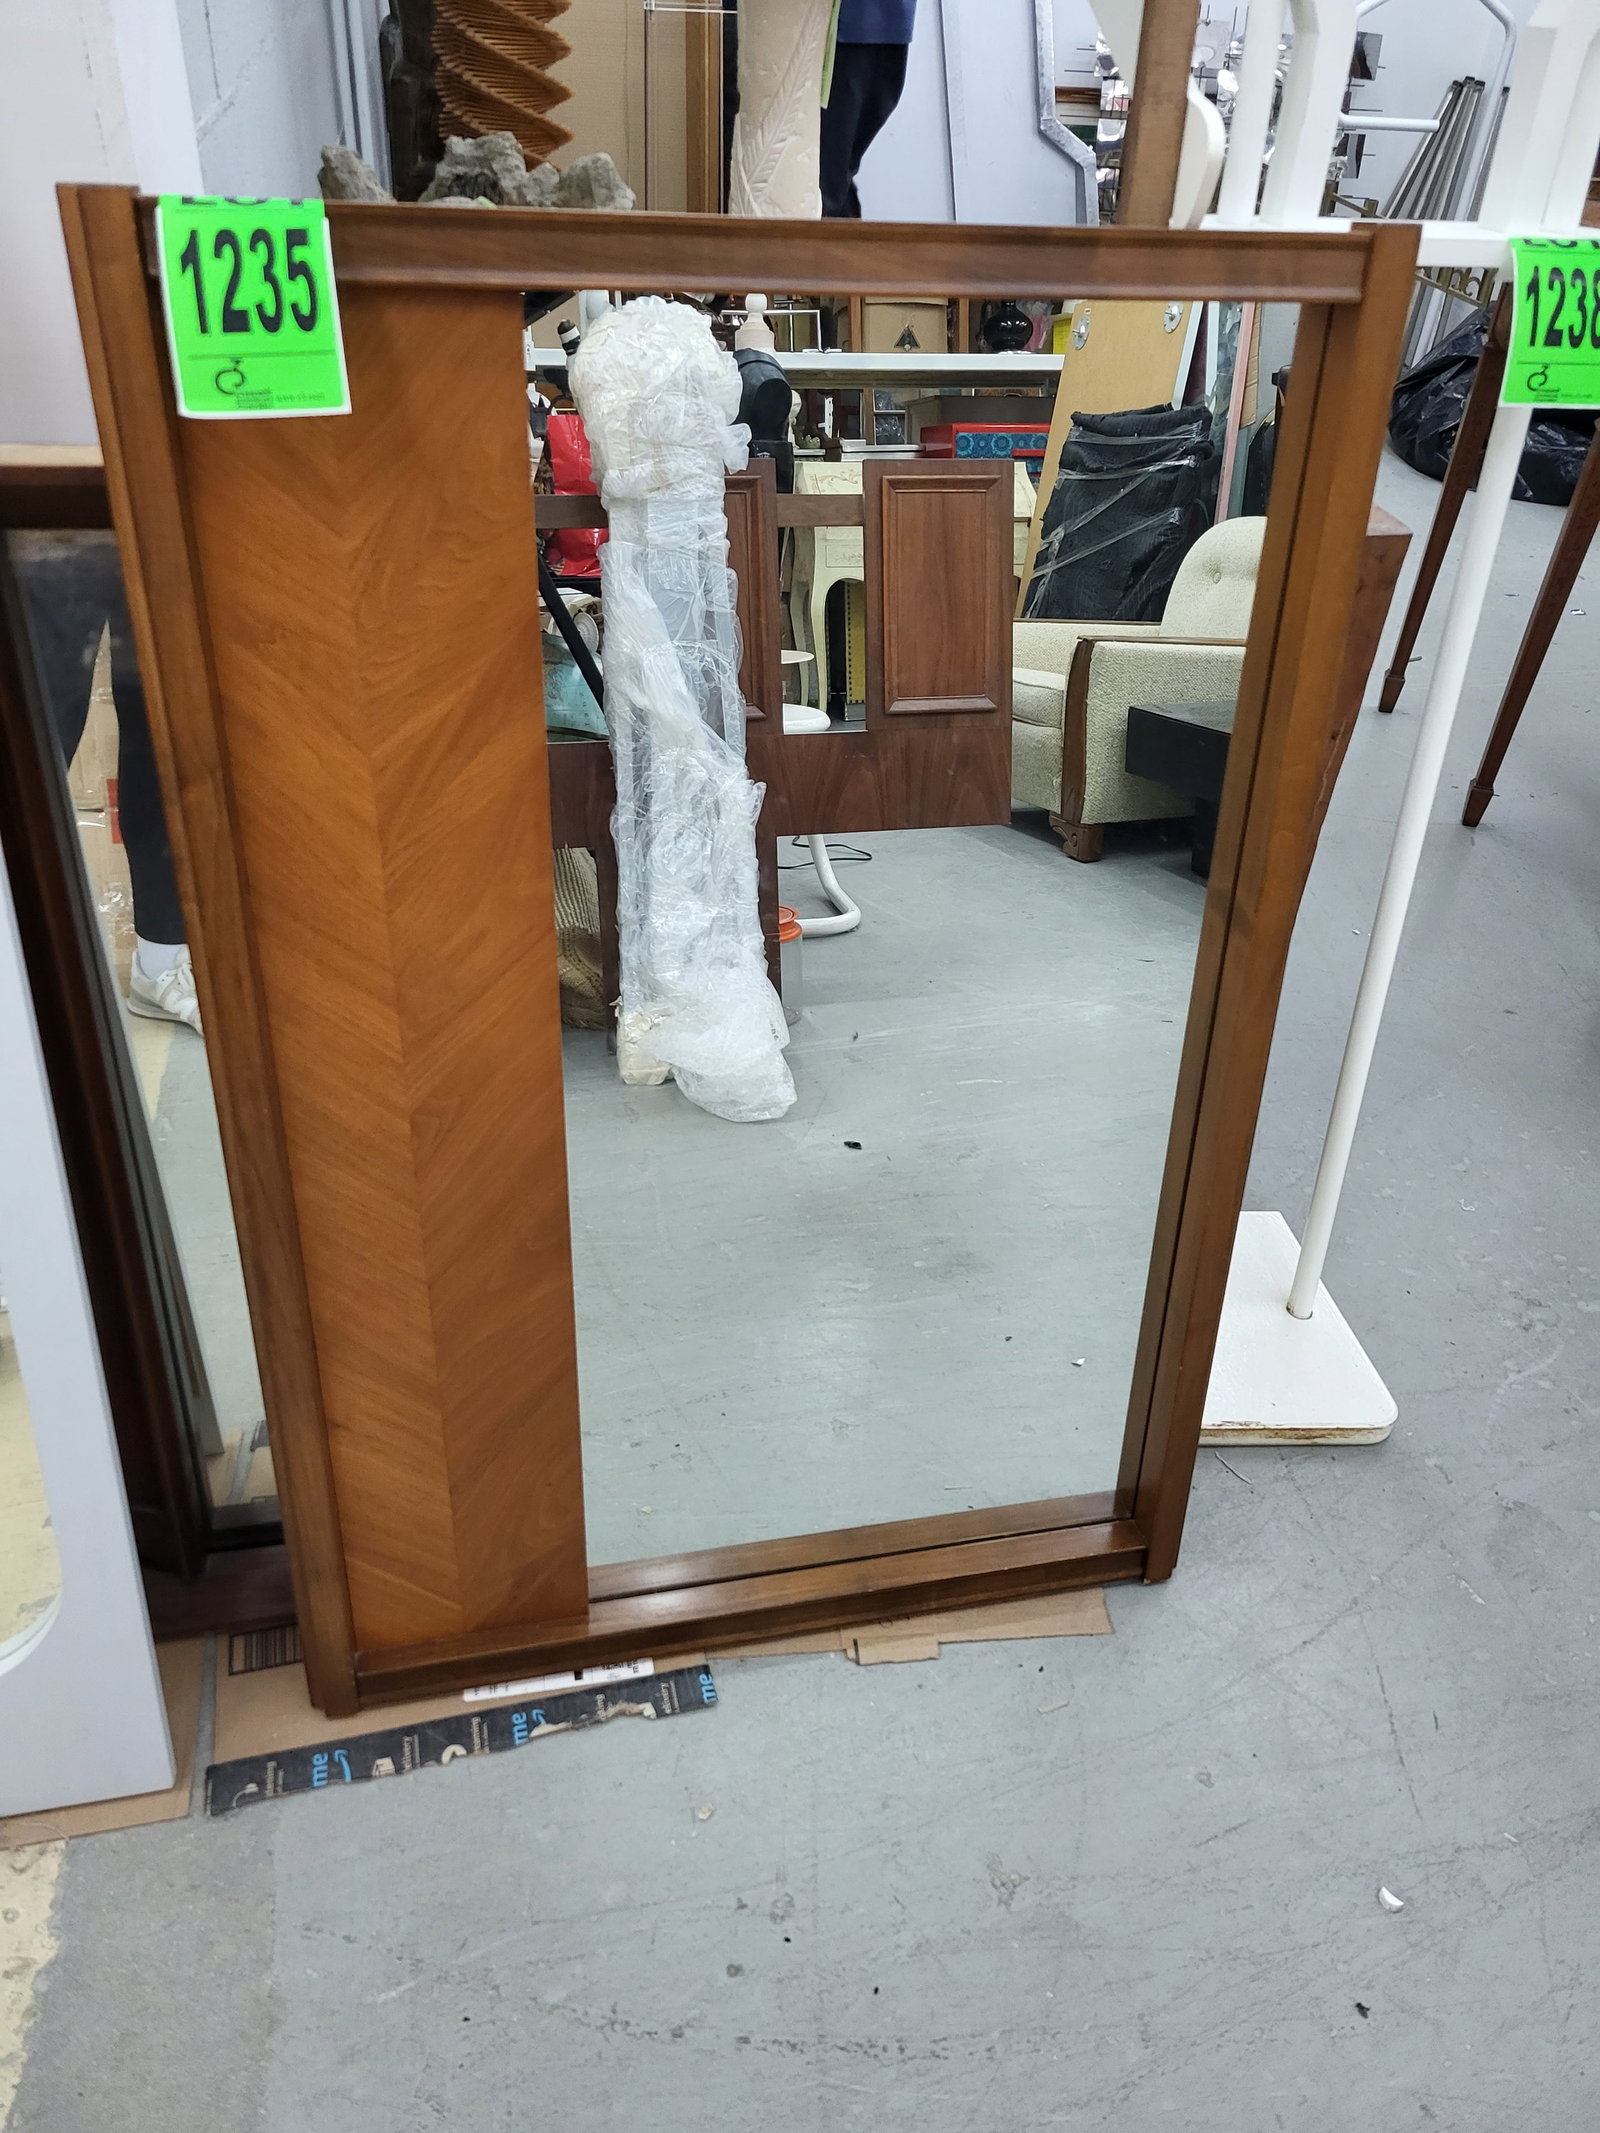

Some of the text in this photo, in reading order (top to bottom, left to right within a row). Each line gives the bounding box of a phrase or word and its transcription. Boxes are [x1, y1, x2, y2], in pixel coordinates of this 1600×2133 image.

[181, 228, 318, 333] 1235
[699, 1673, 718, 1704] me
[512, 1712, 529, 1746] me
